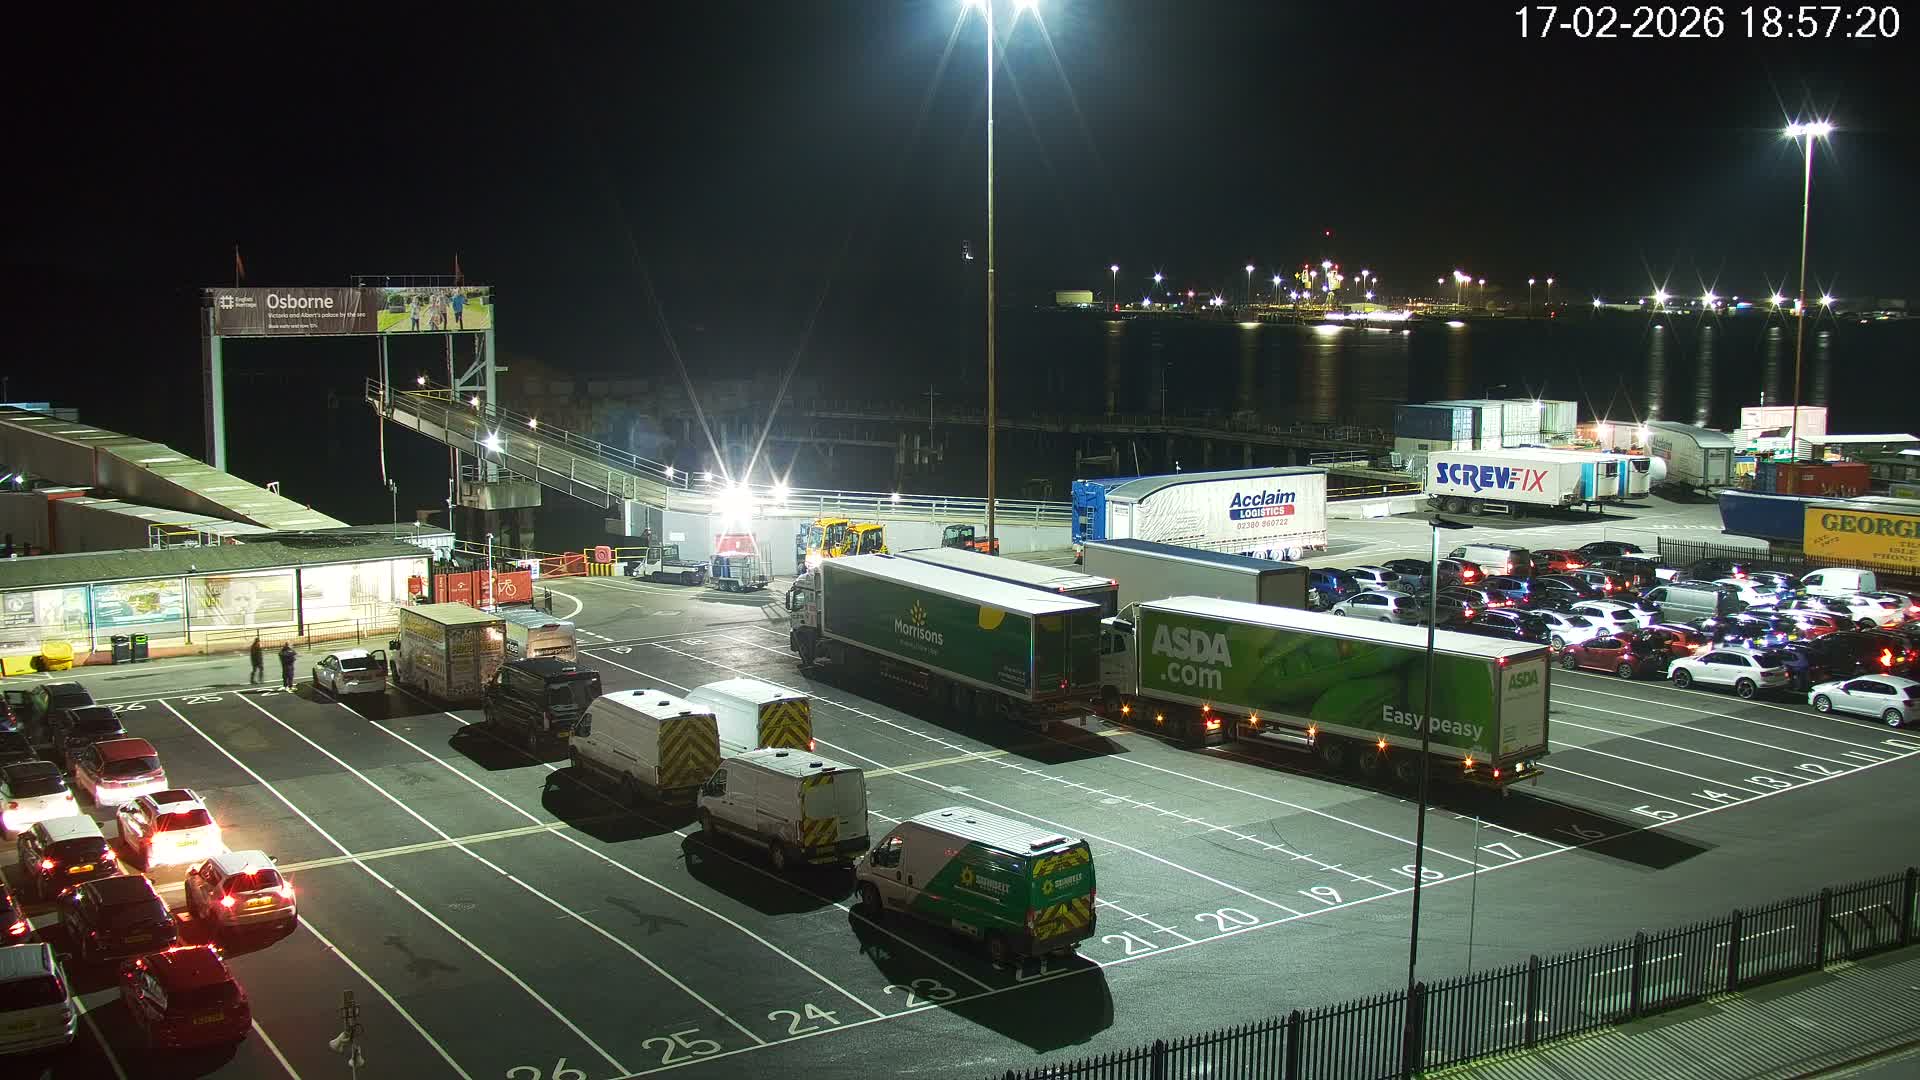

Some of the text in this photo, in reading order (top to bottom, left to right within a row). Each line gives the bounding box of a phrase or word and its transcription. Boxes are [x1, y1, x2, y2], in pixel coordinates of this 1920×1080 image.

[266, 294, 334, 310] Osborne
[1437, 463, 1549, 493] SCREWFIX
[1229, 489, 1296, 508] Acclaim
[1240, 506, 1285, 518] LOGISTICS
[1237, 521, 1260, 530] 02380
[1872, 552, 1918, 562] PHONE
[894, 619, 943, 646] Morrisons
[1152, 624, 1232, 667] ASDA
[1161, 662, 1222, 690] .com
[1509, 669, 1538, 691] ASDA
[110, 702, 147, 713] 26
[182, 693, 223, 705] 25
[1383, 704, 1424, 730] Easy
[1429, 716, 1485, 742] peasy
[1841, 751, 1886, 763] 11
[1794, 763, 1843, 776] 12
[1744, 776, 1793, 790] 13
[1691, 789, 1741, 804] 14
[1629, 805, 1680, 821] 15
[1554, 824, 1607, 840] 16
[1474, 842, 1524, 861] 17
[1390, 864, 1444, 882] 18
[1298, 886, 1343, 906] 19
[1194, 907, 1260, 933] 20
[1102, 931, 1159, 956] 21
[883, 978, 957, 1008] 23
[767, 1002, 842, 1035] 24
[641, 1027, 722, 1066] 25
